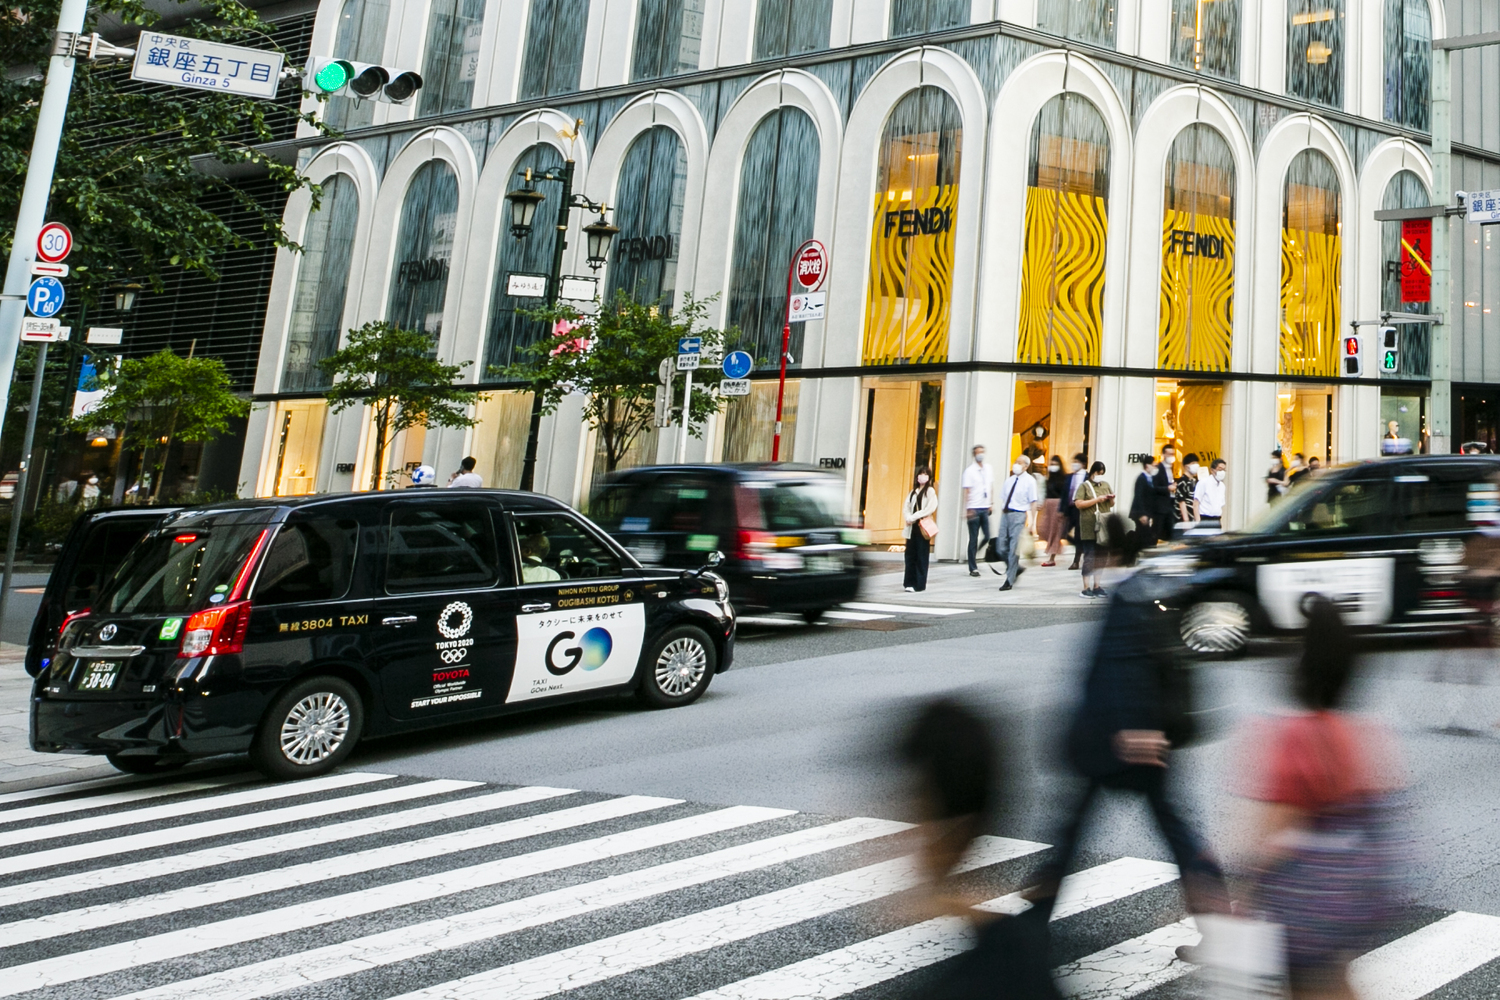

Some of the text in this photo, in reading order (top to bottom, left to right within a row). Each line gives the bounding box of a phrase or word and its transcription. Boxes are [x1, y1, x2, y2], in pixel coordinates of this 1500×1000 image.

[150, 35, 191, 50] 中央区
[146, 47, 271, 82] 銀座五丁目
[181, 71, 230, 88] Ginza 5
[1471, 191, 1491, 199] 中央区
[885, 207, 952, 238] FENDI
[45, 233, 65, 252] 30
[617, 234, 673, 264] FENDI
[1172, 230, 1224, 260] FENDI
[398, 259, 446, 285] FENDI
[799, 258, 821, 276] 消火栓
[33, 287, 50, 313] P
[43, 302, 55, 313] 60
[820, 457, 846, 469] FENDI
[558, 584, 620, 596] NIHON KOTSU GROUP
[558, 595, 620, 607] OUGIBASHI KOTSU
[340, 614, 369, 626] TAXI
[538, 611, 624, 629] タクシーに未来をのせて
[435, 638, 474, 650] TOKYO 2020
[432, 669, 470, 681] TOYOTA
[532, 678, 548, 686] TAXI
[530, 686, 547, 694] GOes
[411, 691, 482, 708] START YOUR IMPOSSIBLE
